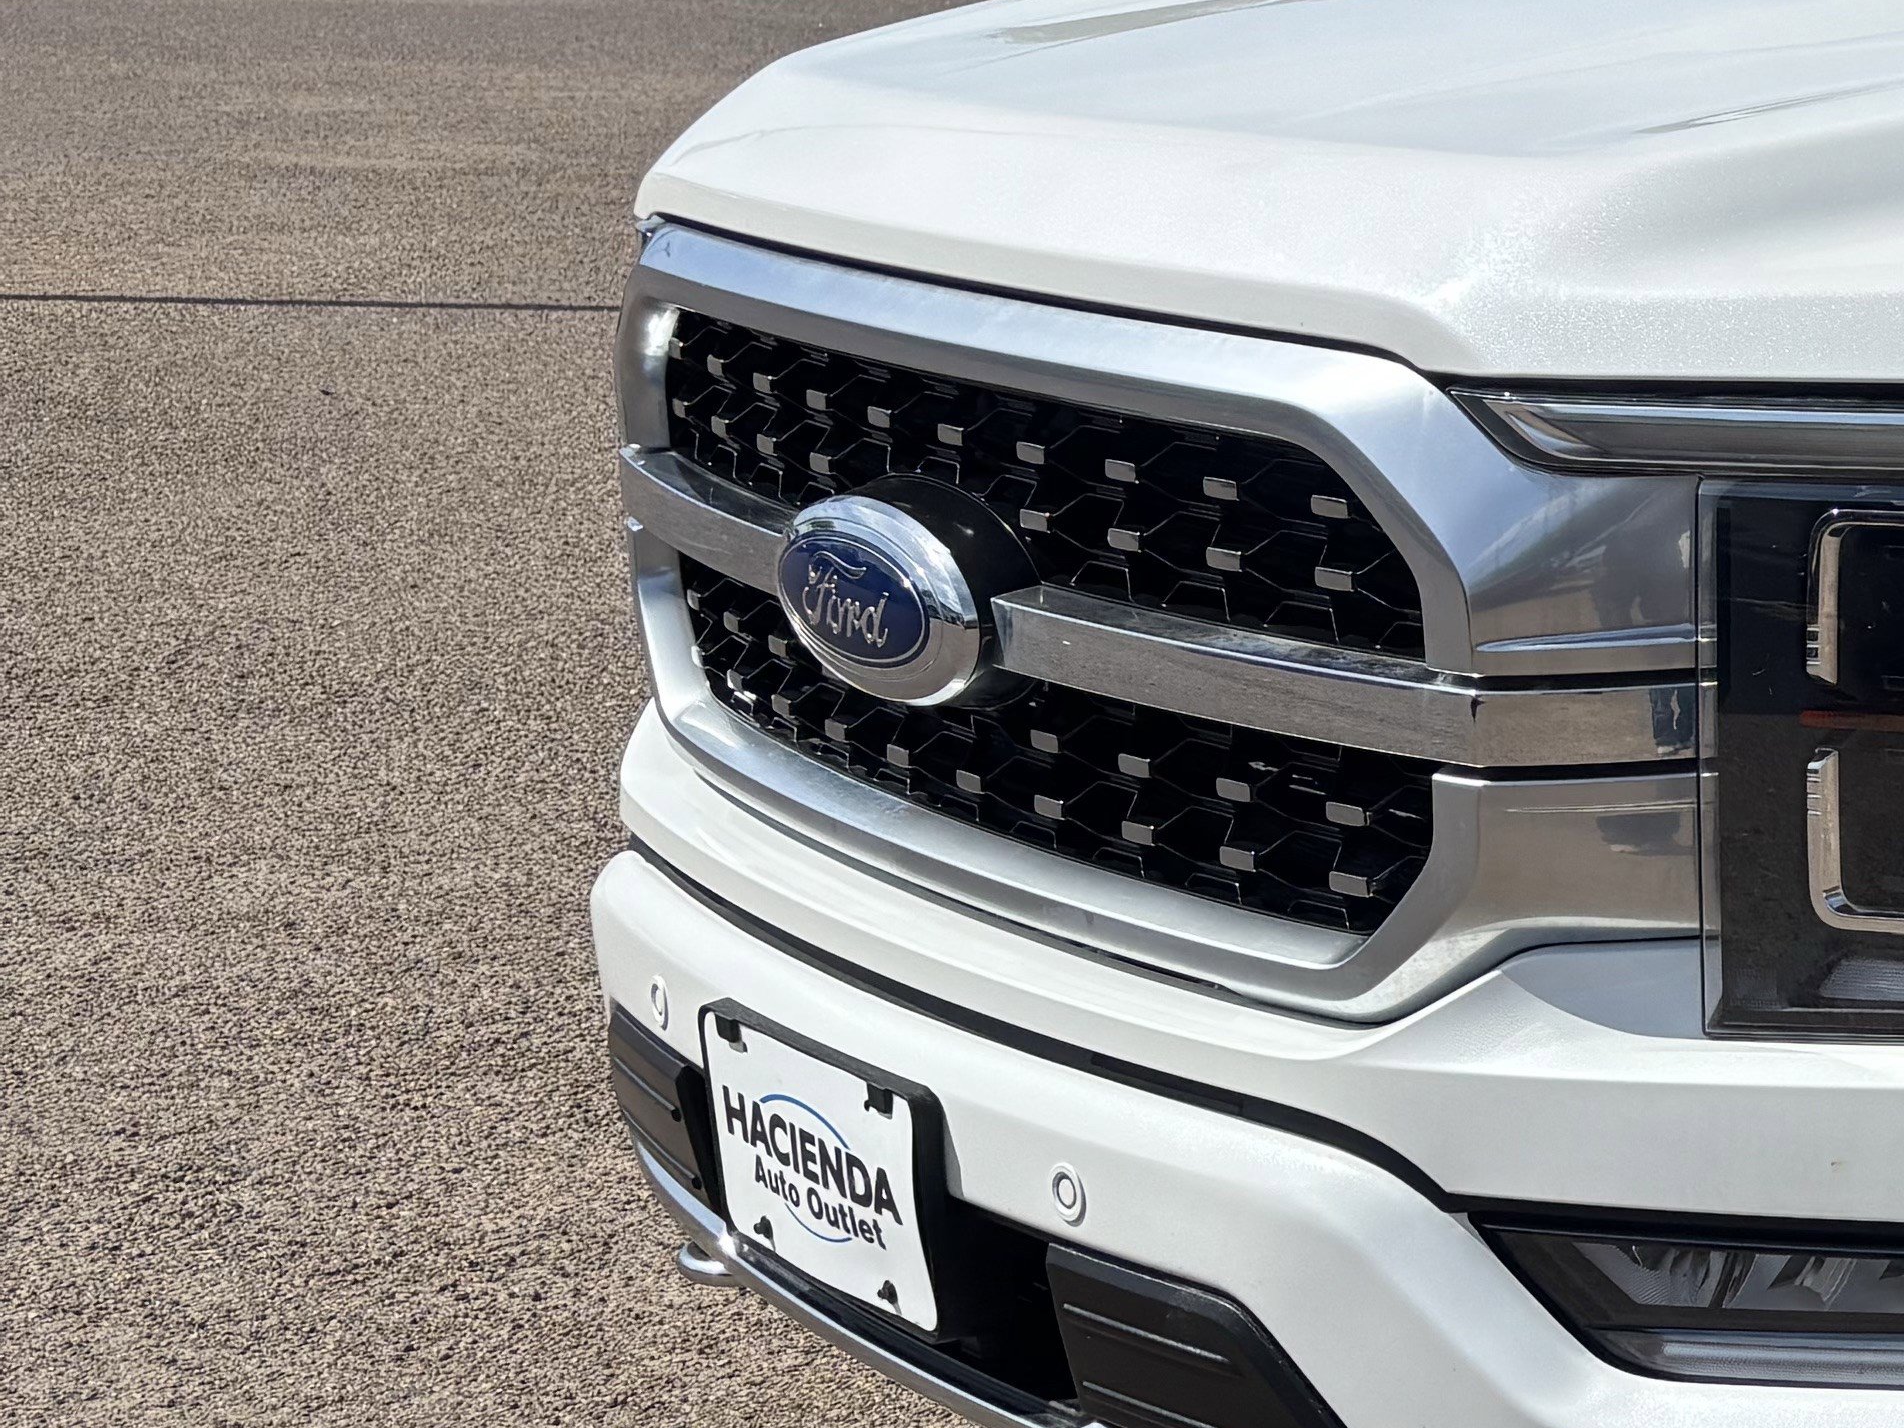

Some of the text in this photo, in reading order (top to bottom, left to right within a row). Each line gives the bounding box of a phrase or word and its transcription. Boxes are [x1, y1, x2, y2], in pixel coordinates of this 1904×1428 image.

[802, 549, 890, 648] Ford
[721, 1084, 904, 1227] HACIENDA
[753, 1153, 888, 1252] Auto Outlet
